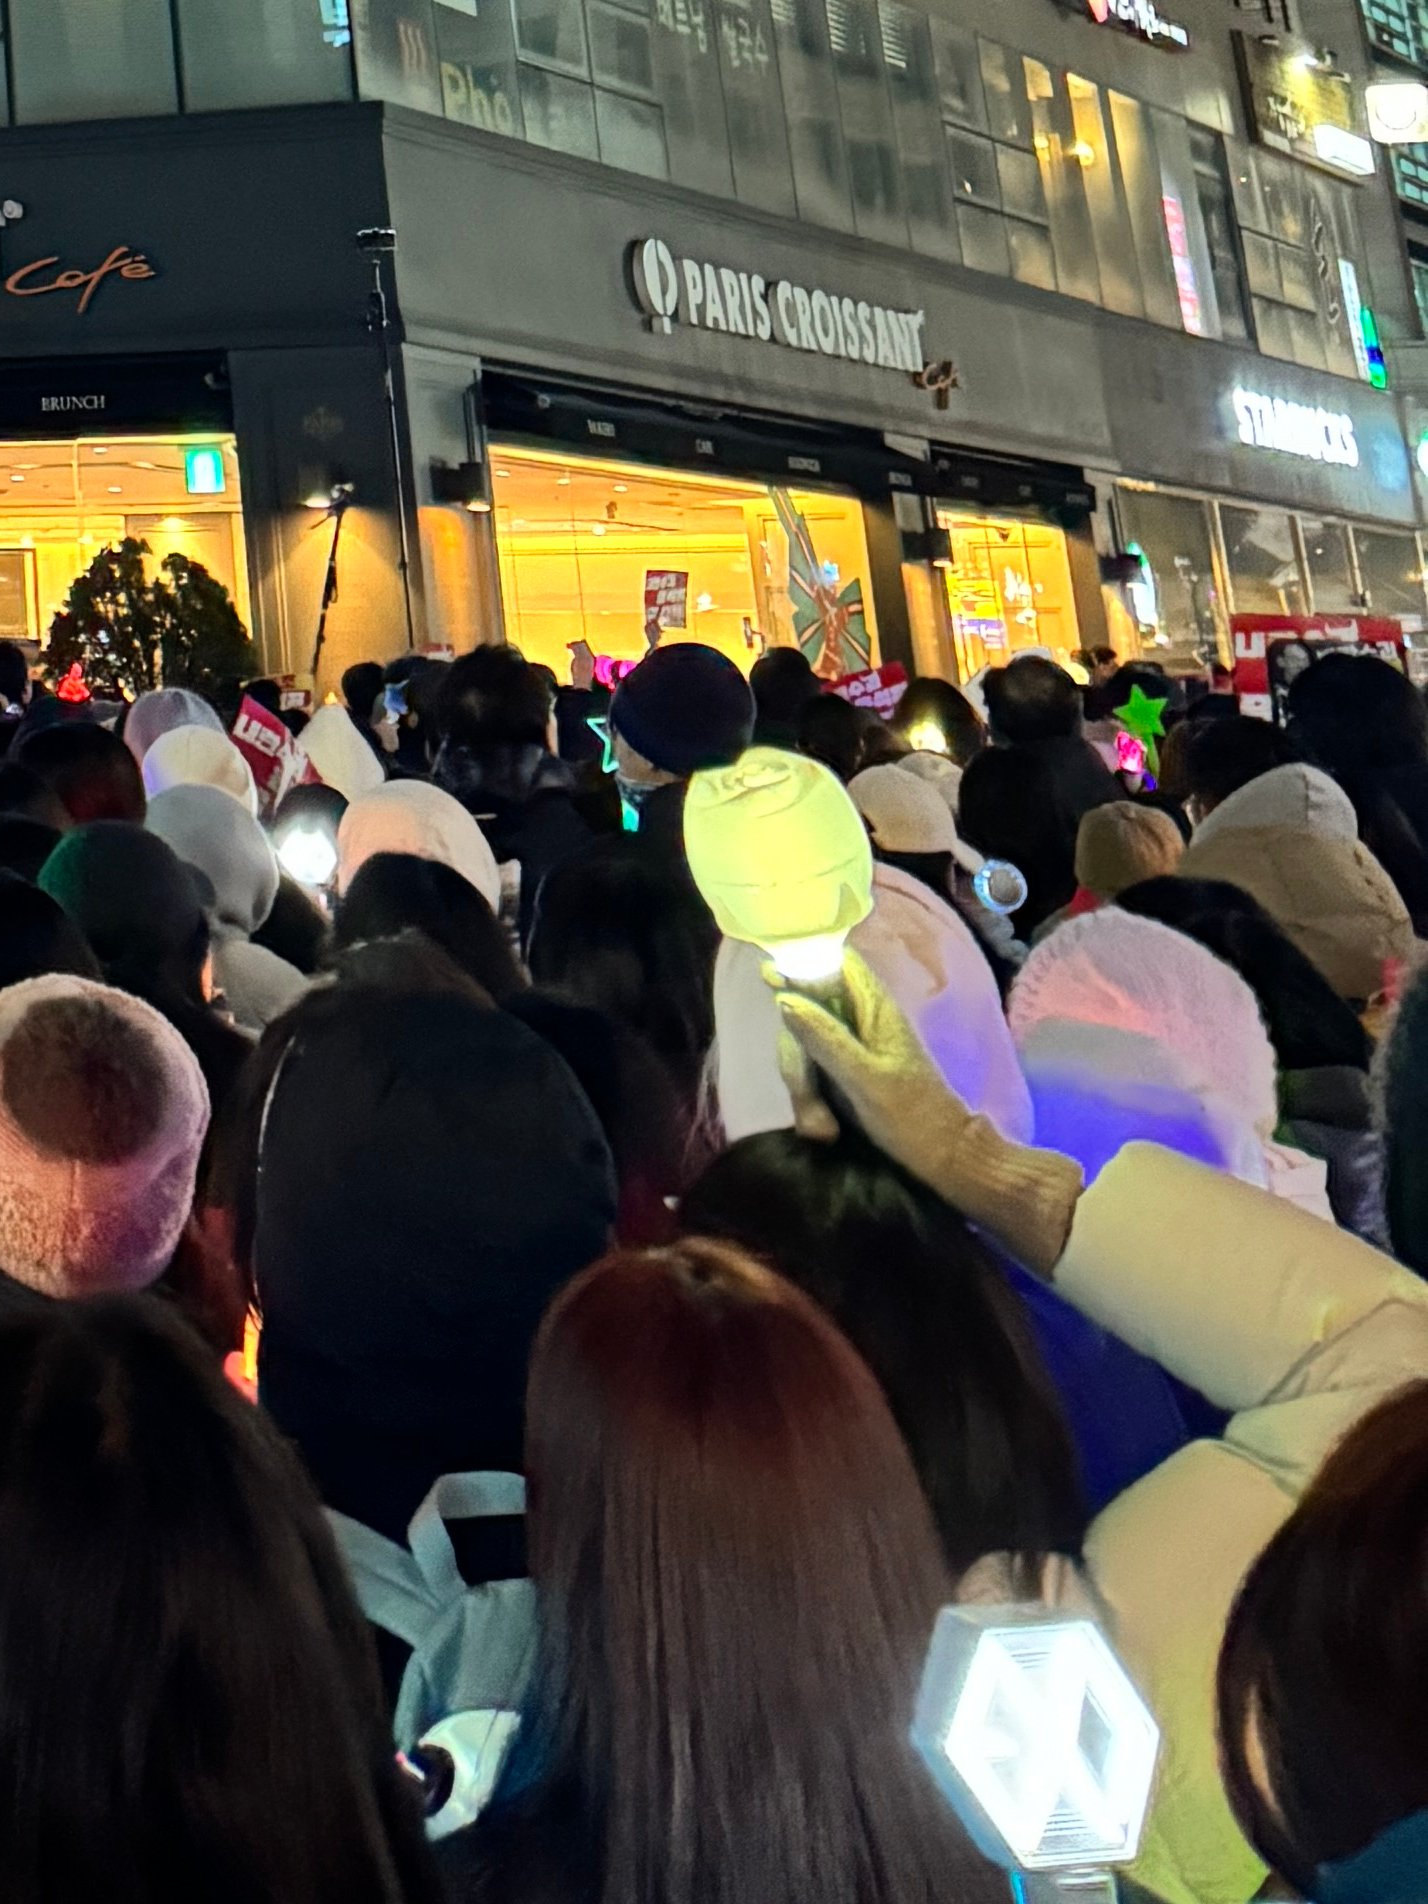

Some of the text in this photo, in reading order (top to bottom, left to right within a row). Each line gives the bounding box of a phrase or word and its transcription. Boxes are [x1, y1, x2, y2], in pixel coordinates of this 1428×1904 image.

[682, 258, 925, 373] PARIS CROISSANT
[40, 394, 106, 412] BRUNCH
